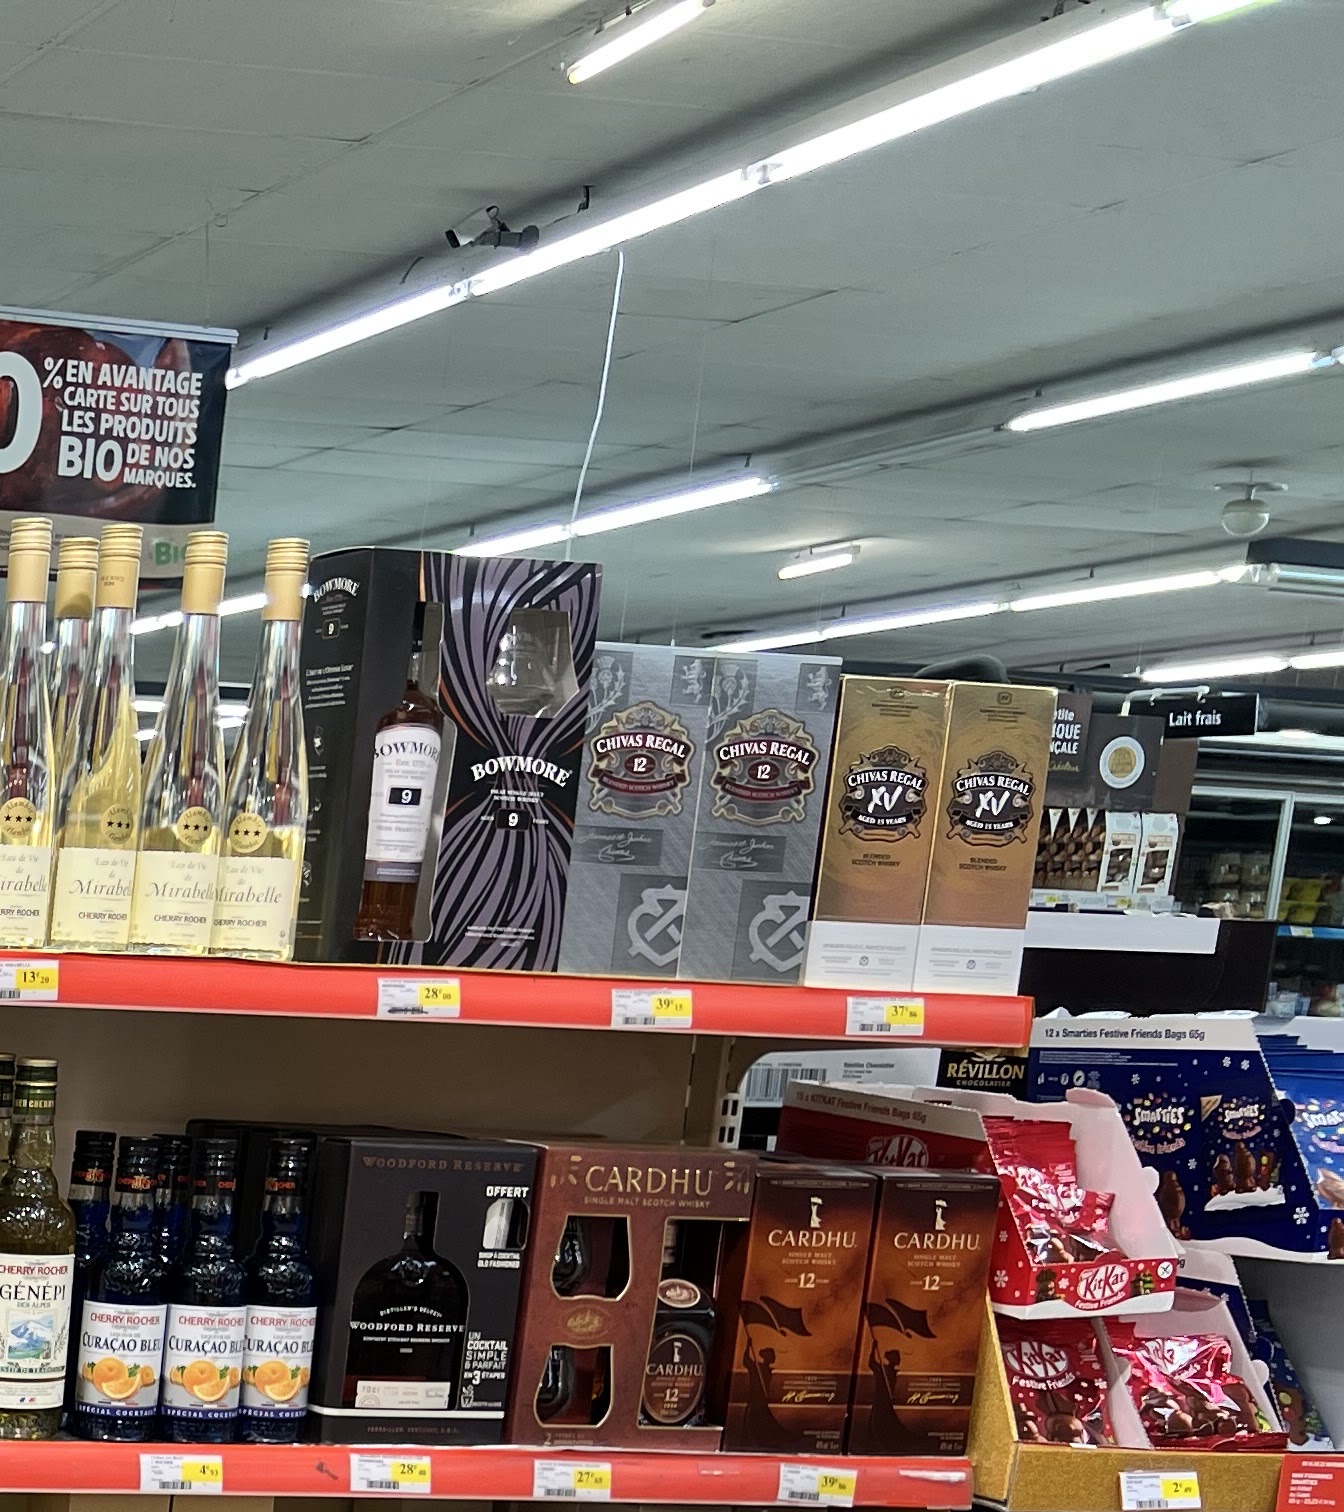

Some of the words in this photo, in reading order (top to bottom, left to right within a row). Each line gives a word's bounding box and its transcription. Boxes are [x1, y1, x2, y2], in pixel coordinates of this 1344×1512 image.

[66, 360, 92, 384] EN
[98, 364, 203, 396] AVANTAGE
[64, 386, 116, 409] CARTE
[119, 393, 152, 414] SUR
[157, 396, 200, 418] TOUS
[61, 409, 94, 434] LES
[99, 413, 197, 445] PRODUITS
[58, 435, 122, 481] BIO
[127, 442, 150, 465] DE
[154, 446, 195, 469] NOS
[124, 470, 196, 489] MARQUES.
[1169, 712, 1191, 726] Lait
[1196, 710, 1222, 726] frais
[596, 734, 641, 753] CHIVAS
[645, 733, 686, 759] REGAL
[719, 742, 765, 762] CHIVAS
[769, 741, 812, 767] REGAL
[471, 755, 569, 787] BOWMORE
[633, 756, 646, 773] 12
[756, 764, 770, 781] 12
[847, 771, 885, 789] CHIVAS
[888, 771, 923, 791] REGAL
[402, 790, 412, 804] 9
[867, 786, 898, 815] XV
[975, 791, 1008, 819] XV
[509, 813, 518, 827] 9
[1045, 1029, 1054, 1038] 12
[1062, 1029, 1097, 1039] Smarties
[1100, 1029, 1129, 1039] Festive
[1131, 1029, 1162, 1039] Friends
[1165, 1029, 1186, 1040] Bags
[1189, 1030, 1205, 1040] 65g
[947, 1058, 1024, 1081] RÉVILLON
[363, 1156, 449, 1171] WOODFORD
[453, 1160, 523, 1172] RESERVE
[585, 1166, 714, 1196] CARDHU
[486, 1187, 529, 1197] OFFERT
[678, 1200, 710, 1209] WHISKY
[768, 1230, 855, 1248] CARDHU
[894, 1232, 980, 1251] CARDHU
[0, 1281, 65, 1300] GÉNÉPI
[1082, 1266, 1128, 1300] KitKat
[350, 1321, 413, 1332] WOODFORD
[417, 1323, 465, 1333] RESERVE
[469, 1332, 481, 1340] UN
[83, 1331, 137, 1352] CURAÇAO
[169, 1335, 227, 1355] CURAÇAO
[467, 1341, 508, 1350] COCKTAIL
[466, 1351, 507, 1361] SIMPLE
[1006, 1340, 1068, 1379] KitKat
[472, 1362, 506, 1370] PARFAIT
[472, 1371, 480, 1385] 3
